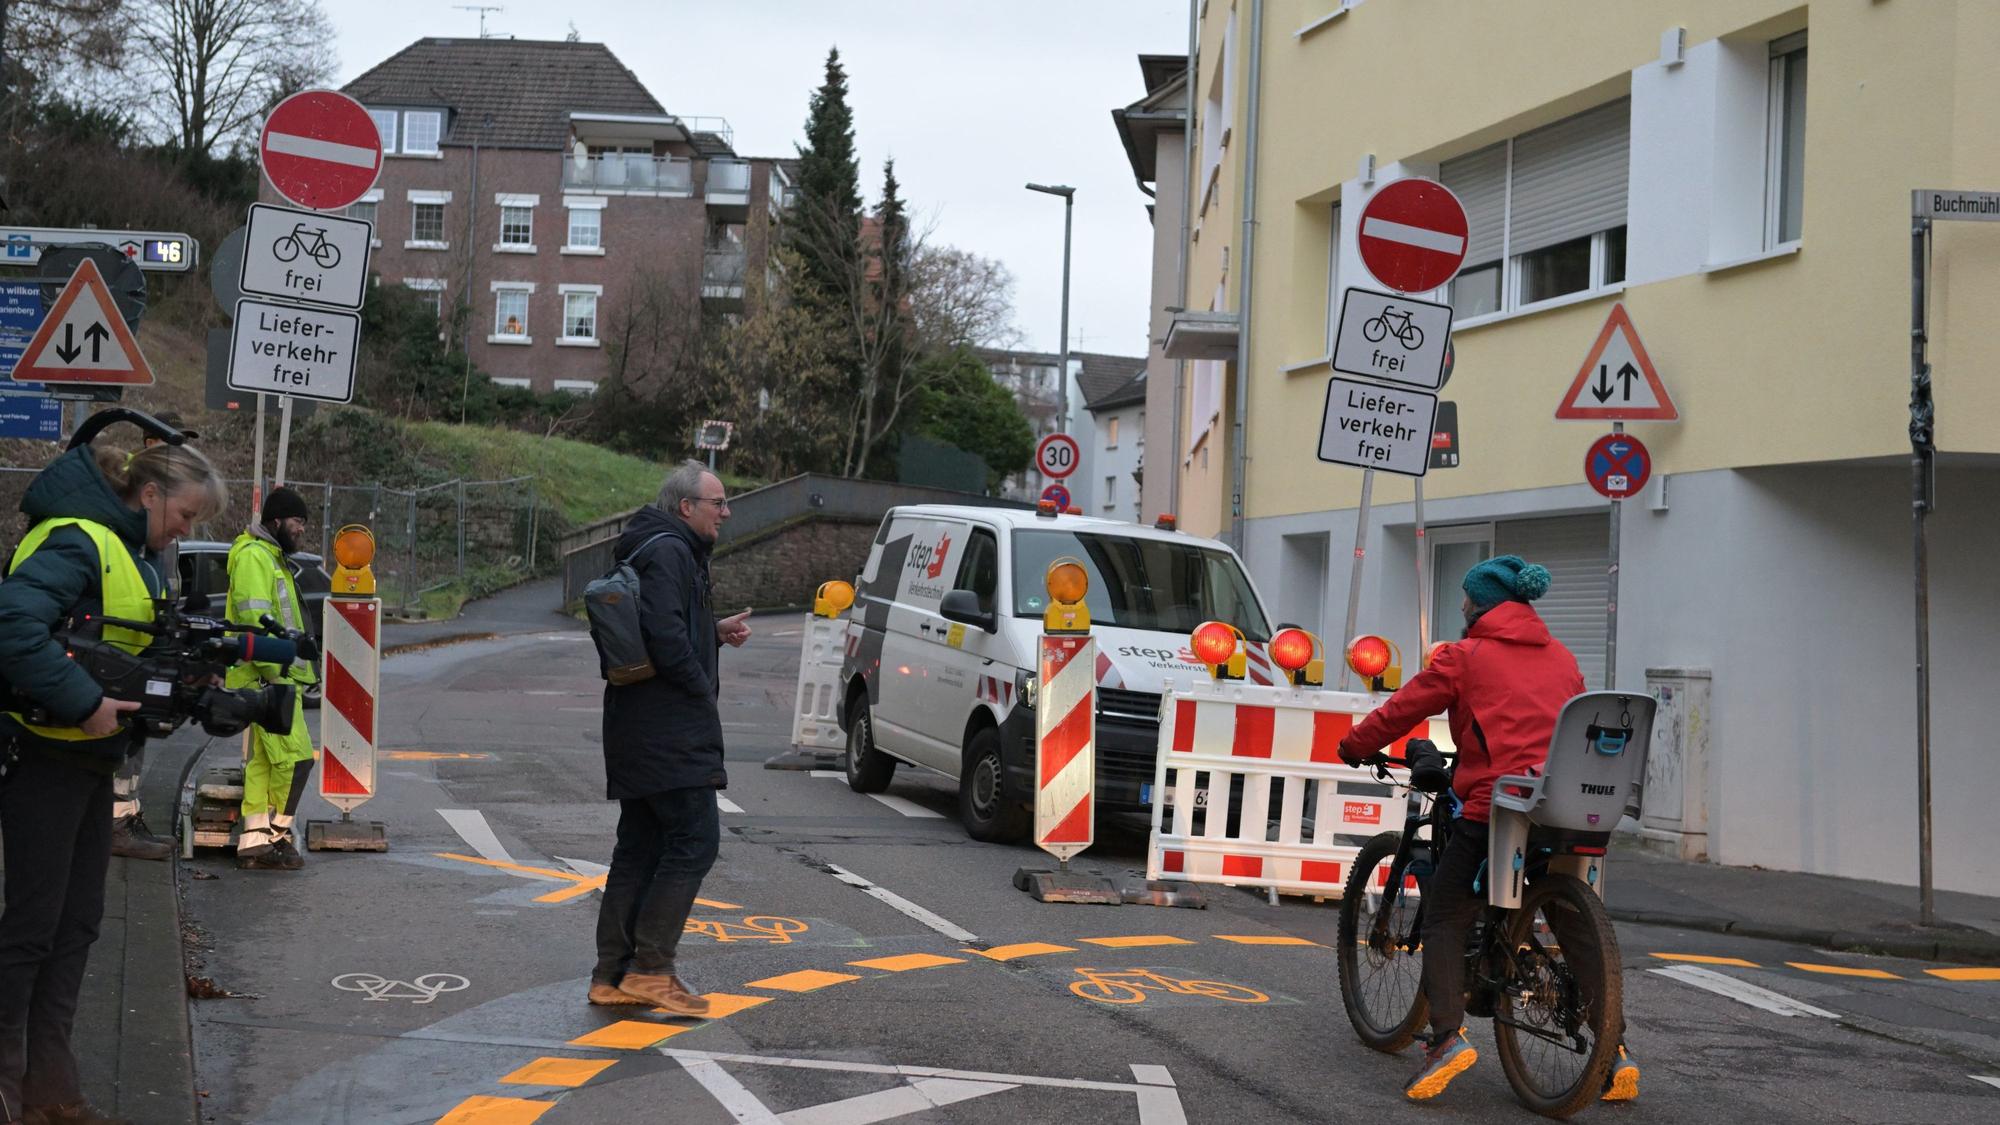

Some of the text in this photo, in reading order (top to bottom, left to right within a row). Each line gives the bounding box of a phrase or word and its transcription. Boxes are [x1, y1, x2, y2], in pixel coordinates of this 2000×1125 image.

[1934, 194, 2000, 213] Buchmühl
[157, 241, 181, 263] 46
[285, 269, 322, 292] frei
[259, 311, 334, 338] Liefer-
[252, 340, 338, 364] verkehr
[1372, 349, 1406, 372] frei
[273, 364, 311, 386] frei
[1347, 389, 1415, 416] Liefer-
[1340, 416, 1417, 441] verkehr
[1046, 446, 1070, 466] 30
[1357, 440, 1392, 461] frei
[907, 540, 932, 578] step
[1118, 645, 1173, 661] step
[1581, 783, 1616, 796] THULE
[1344, 804, 1362, 816] step
